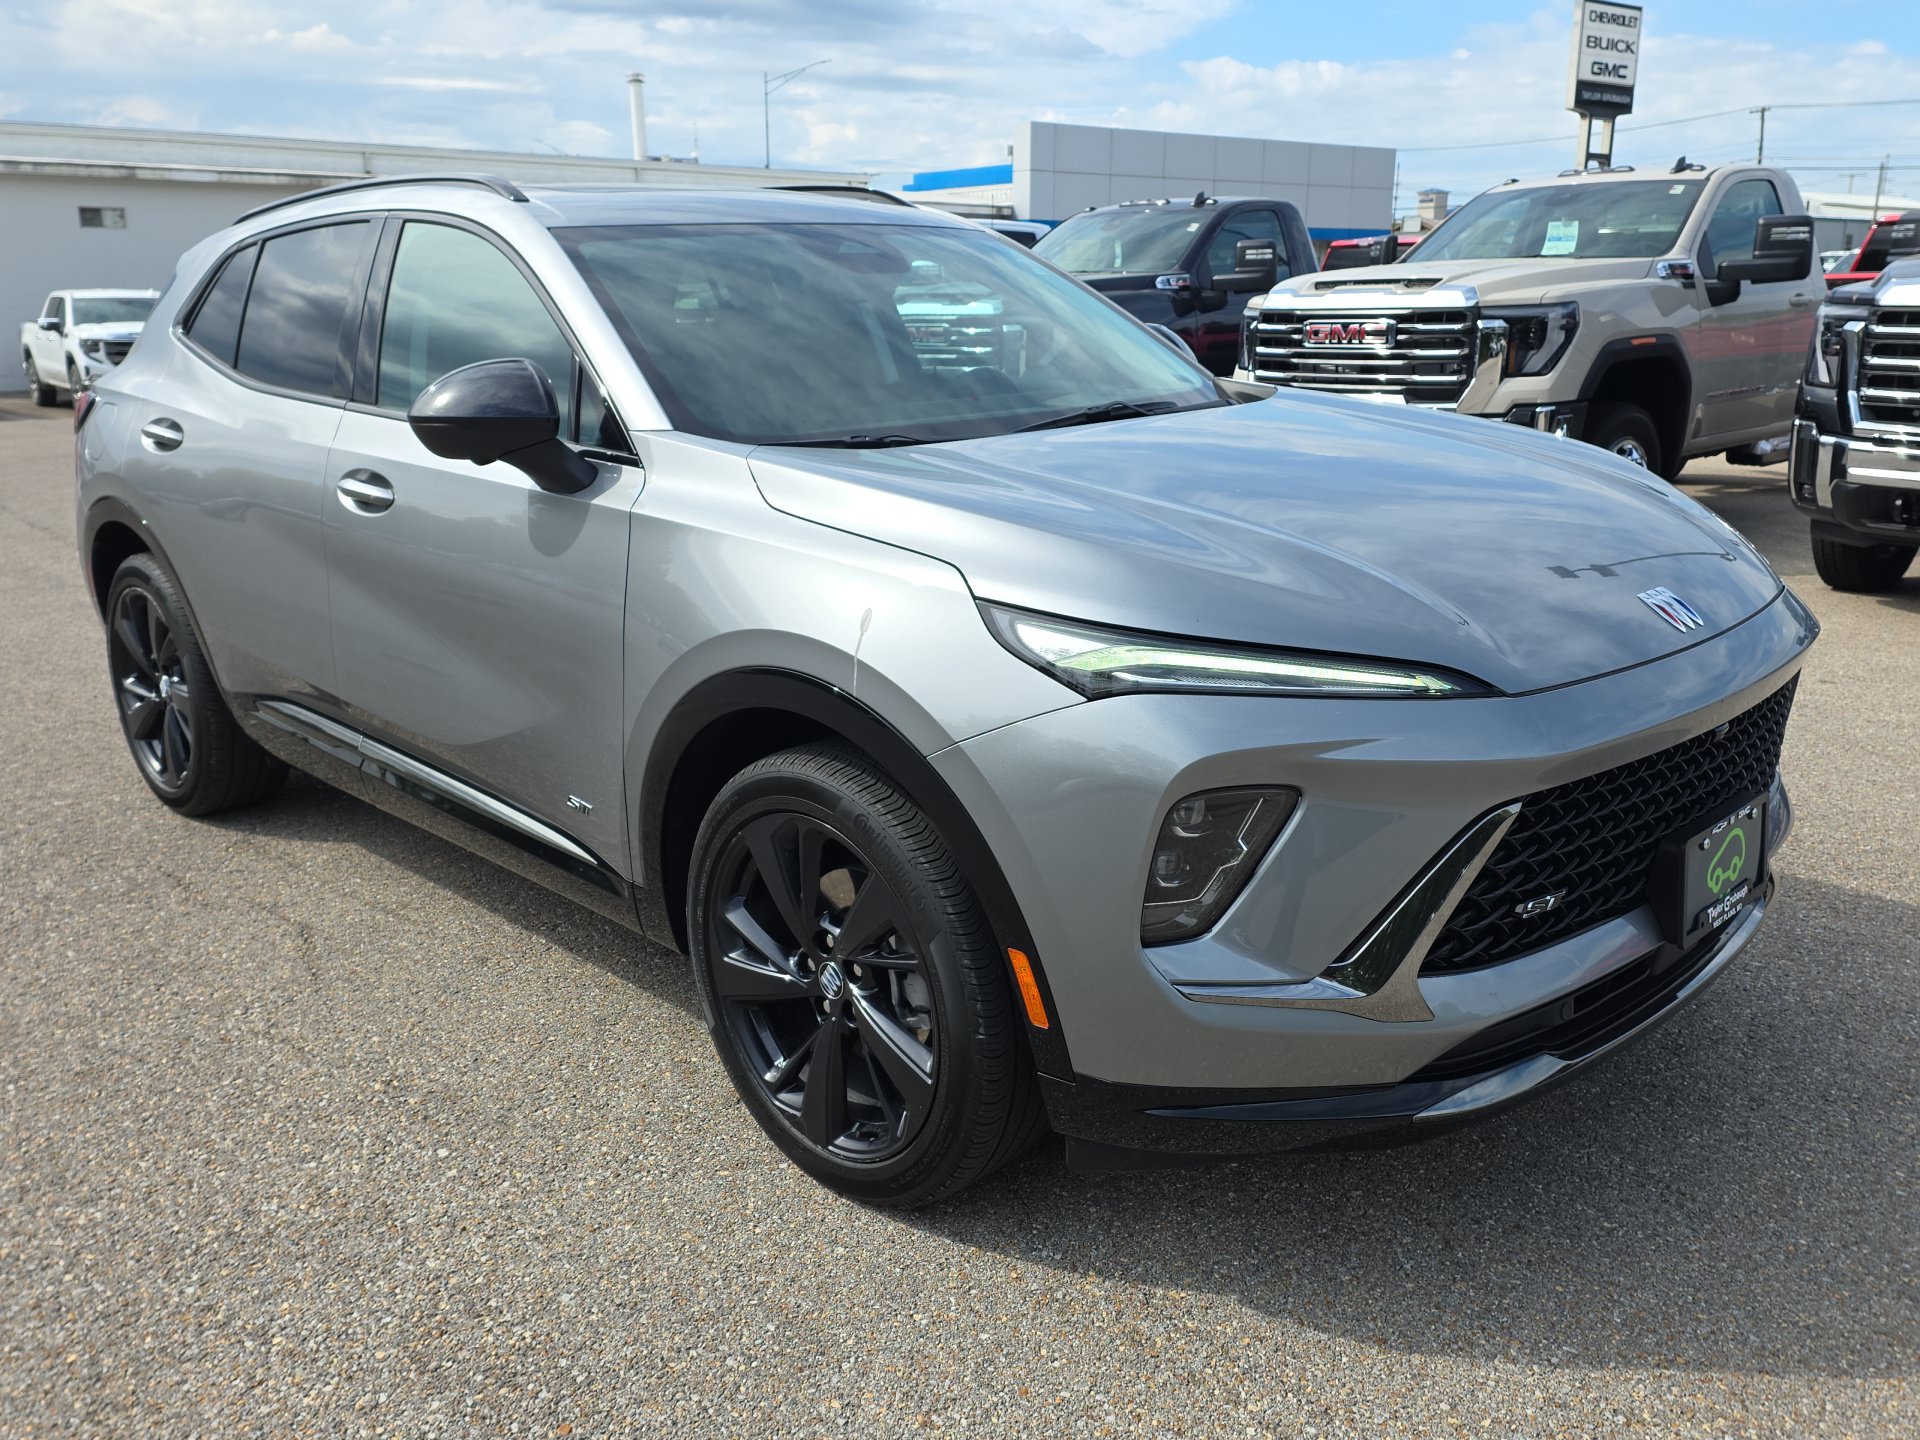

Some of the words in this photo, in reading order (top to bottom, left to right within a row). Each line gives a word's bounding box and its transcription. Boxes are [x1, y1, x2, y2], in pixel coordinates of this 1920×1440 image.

[1588, 9, 1638, 28] CHEVROLET
[1586, 35, 1636, 54] BUICK
[1591, 61, 1628, 79] GMC
[1308, 323, 1387, 344] GMC
[1522, 887, 1567, 919] ST
[1707, 902, 1724, 924] Taylor
